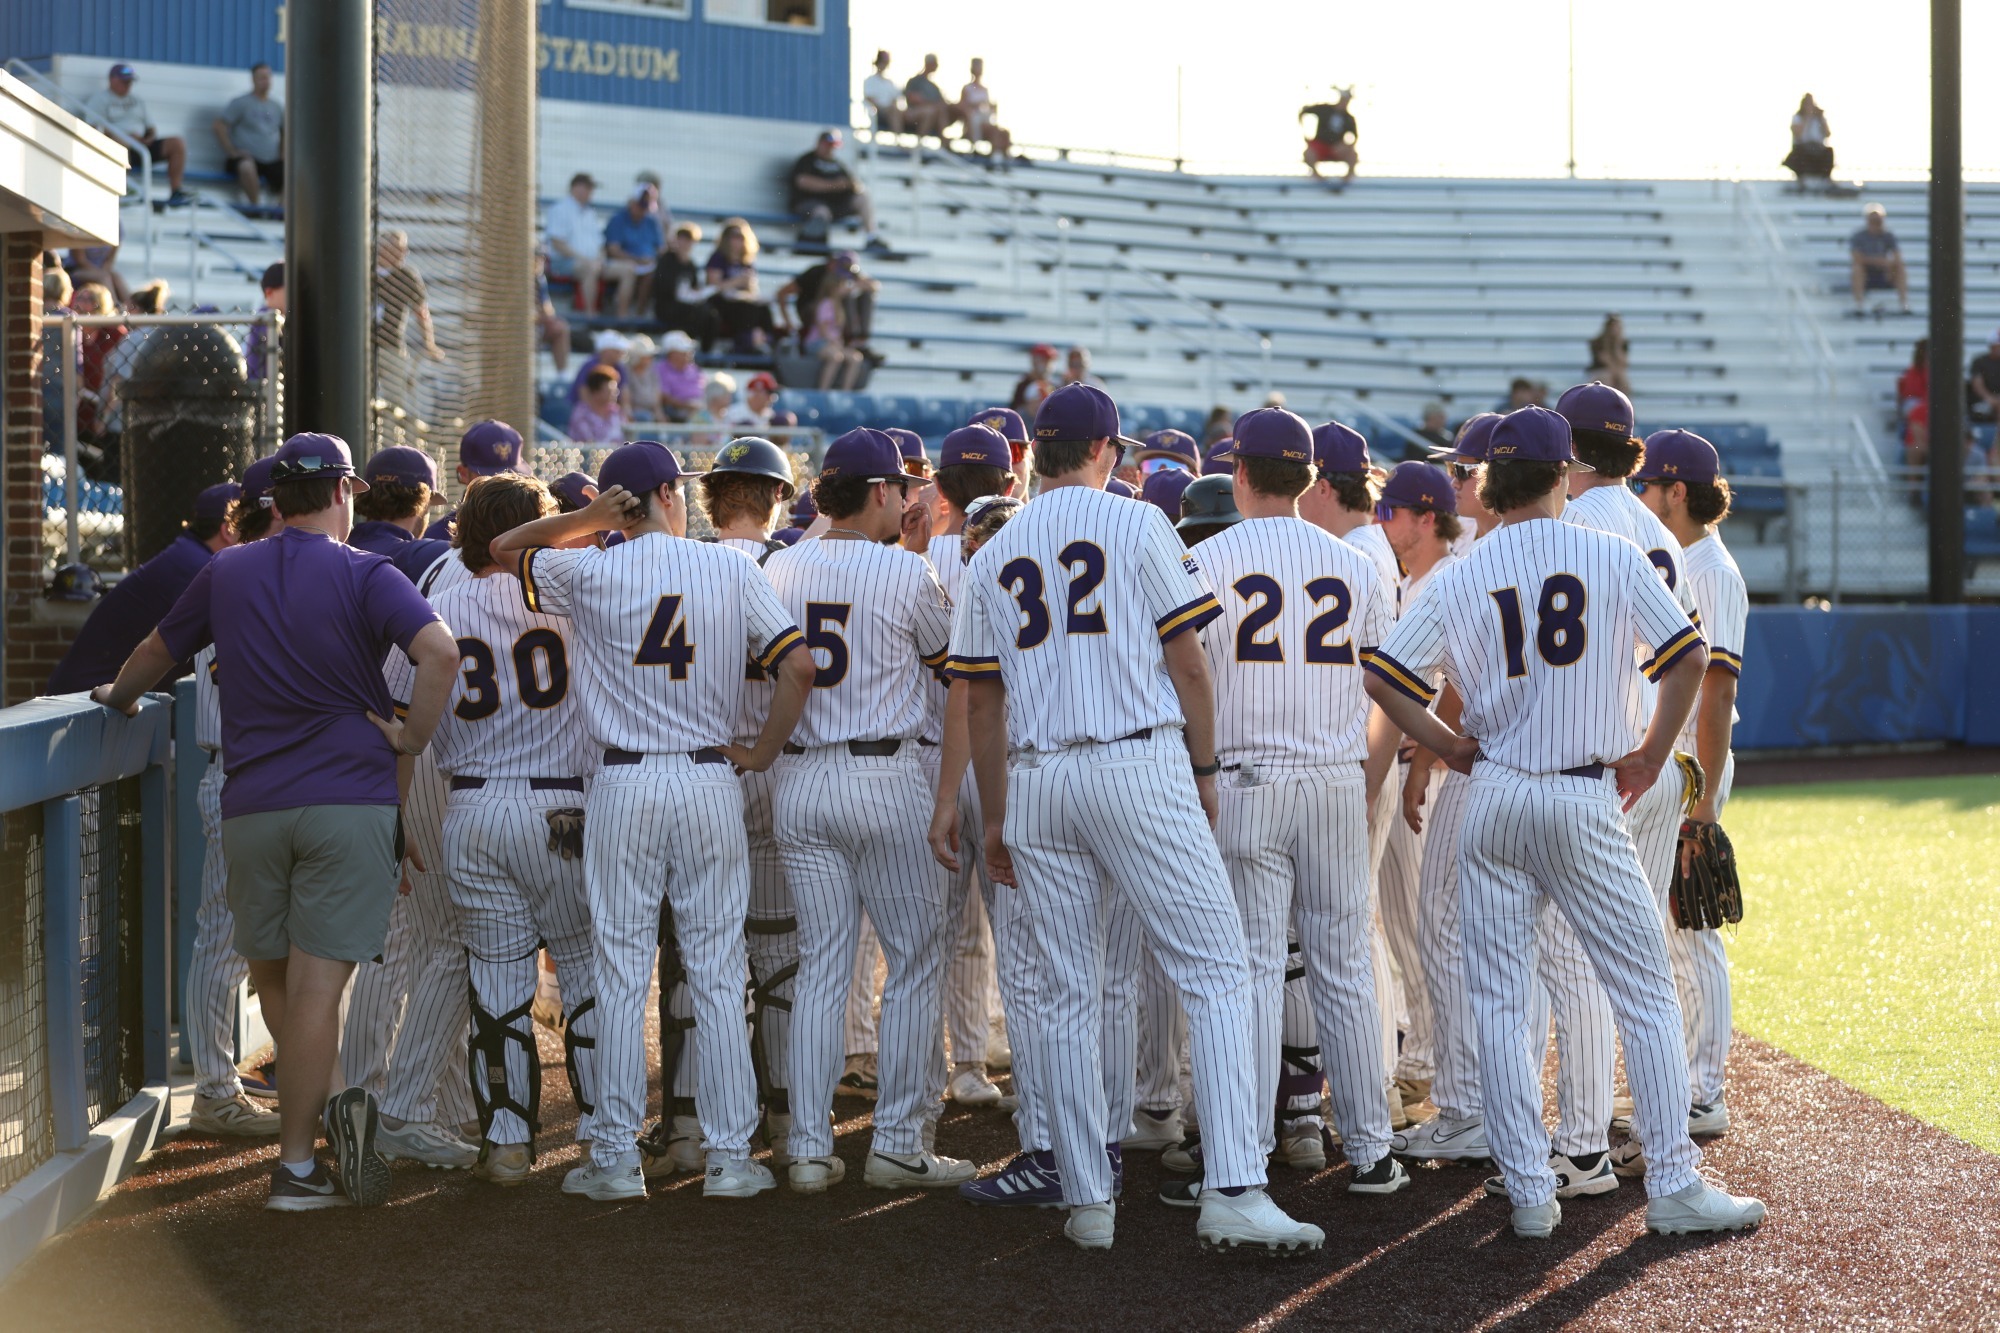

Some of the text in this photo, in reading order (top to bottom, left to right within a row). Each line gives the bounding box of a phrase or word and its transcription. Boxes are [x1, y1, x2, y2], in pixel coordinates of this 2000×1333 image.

[537, 34, 681, 83] STADIUM
[961, 451, 988, 461] WCU
[1036, 428, 1059, 437] WCU
[1282, 449, 1307, 460] WCU
[1493, 446, 1517, 455] WCU
[1604, 421, 1627, 432] WCU
[997, 539, 1109, 650] 32
[1231, 572, 1356, 666] 22
[1488, 571, 1587, 680] 18
[632, 593, 696, 681] 4
[806, 600, 853, 690] 5
[453, 626, 569, 722] 30
